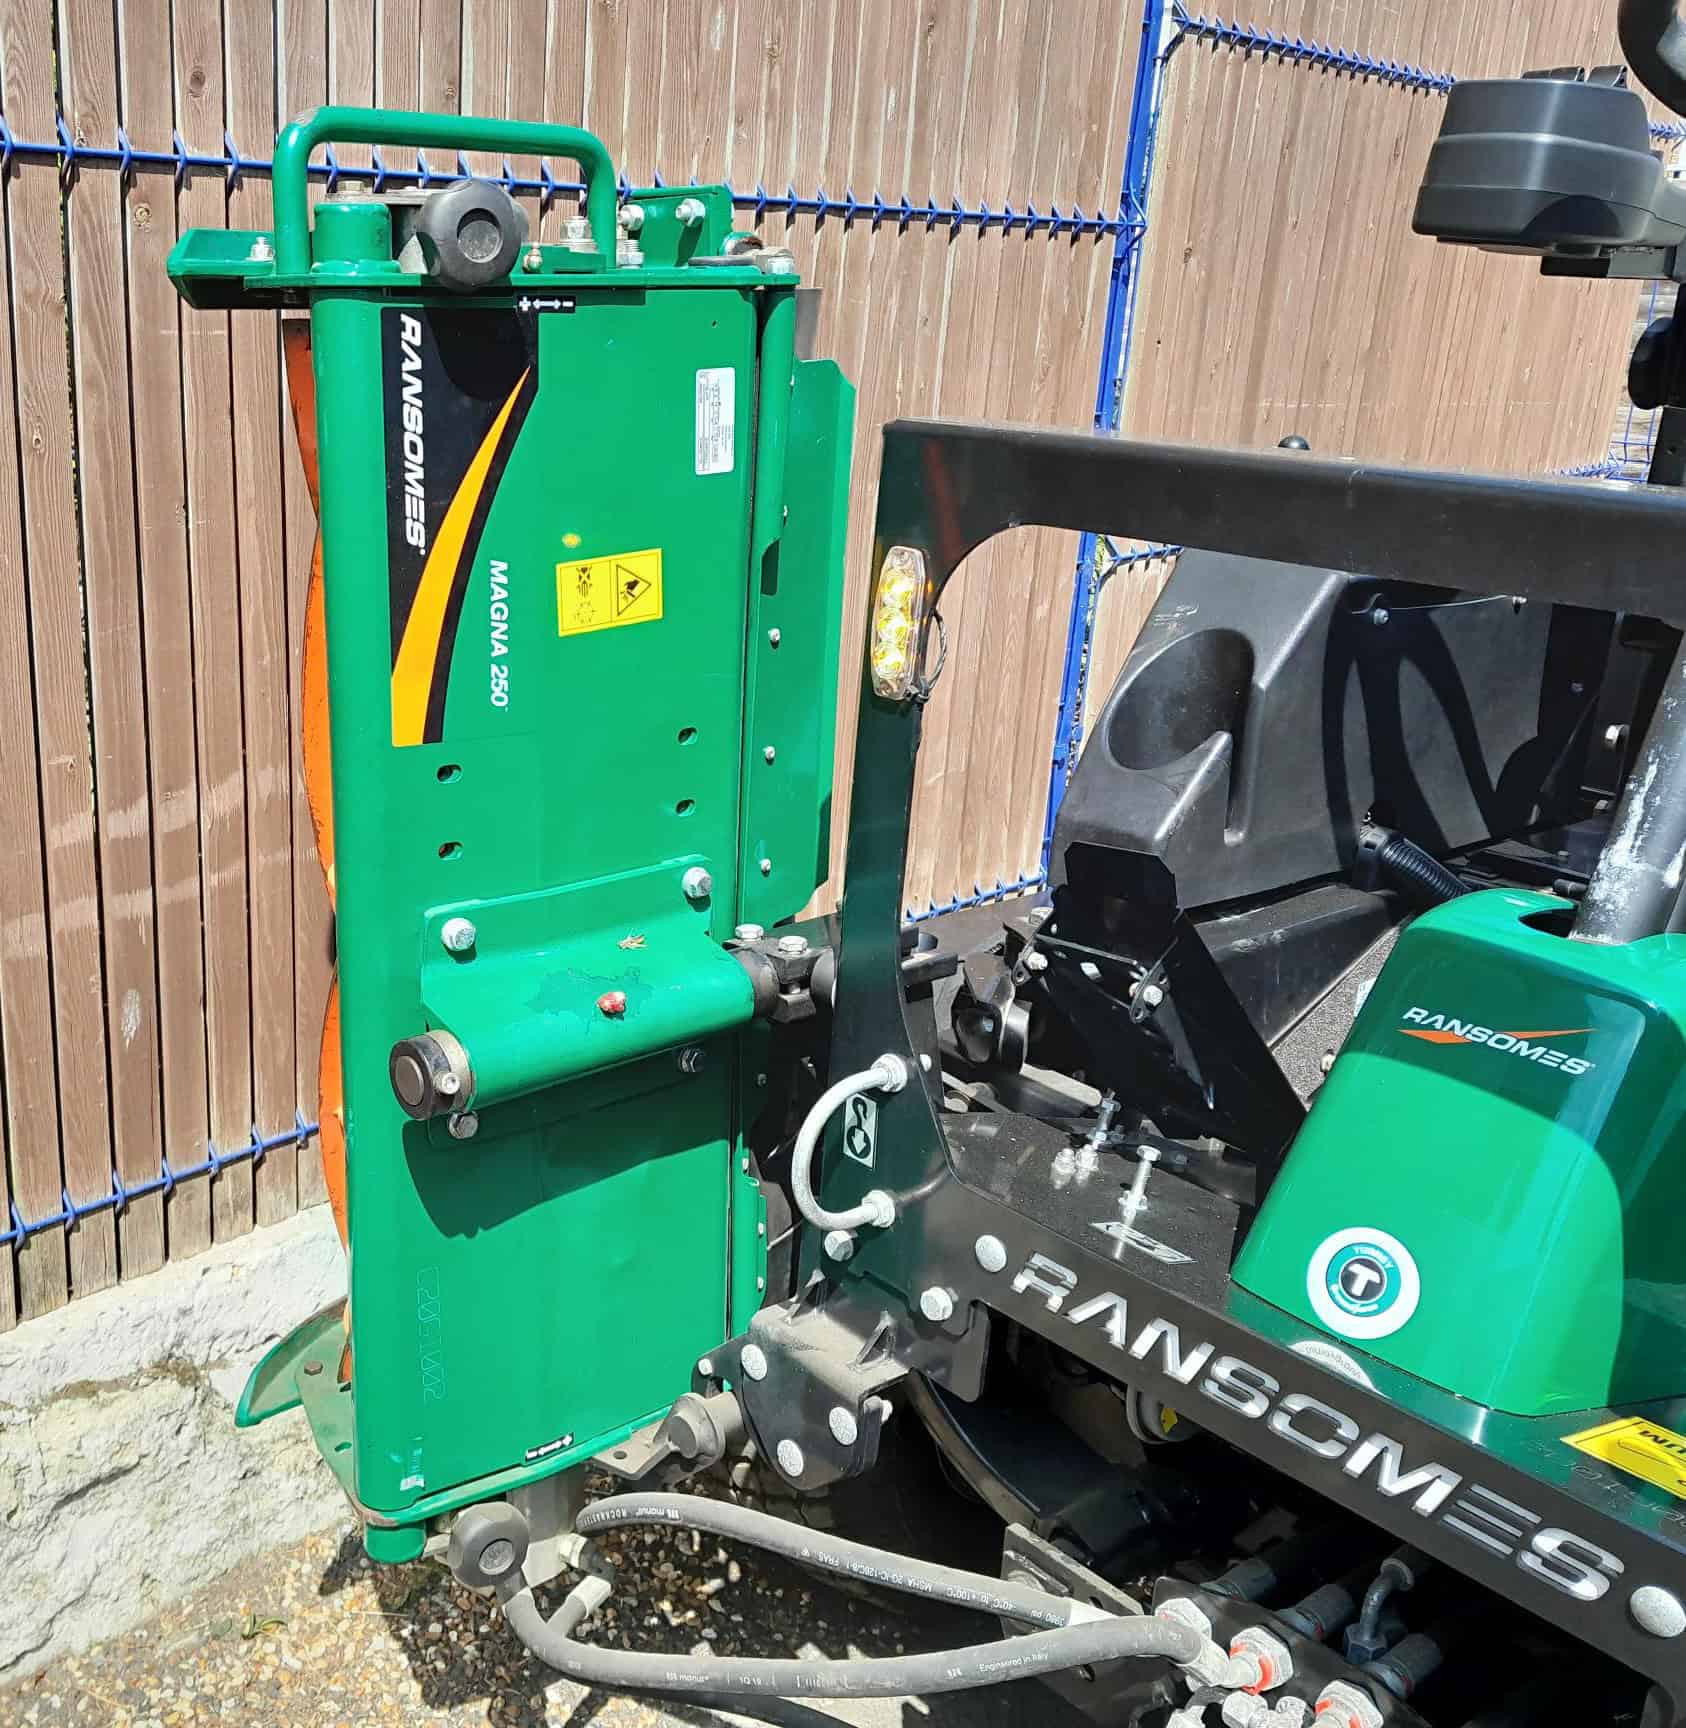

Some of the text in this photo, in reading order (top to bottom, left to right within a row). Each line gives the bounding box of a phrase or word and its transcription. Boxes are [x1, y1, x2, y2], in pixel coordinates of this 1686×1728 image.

[401, 313, 426, 549] RANSOMES
[490, 560, 508, 707] MAGNA 250
[1403, 1007, 1592, 1075] RANSOMES
[1010, 1253, 1625, 1601] RANSOMES
